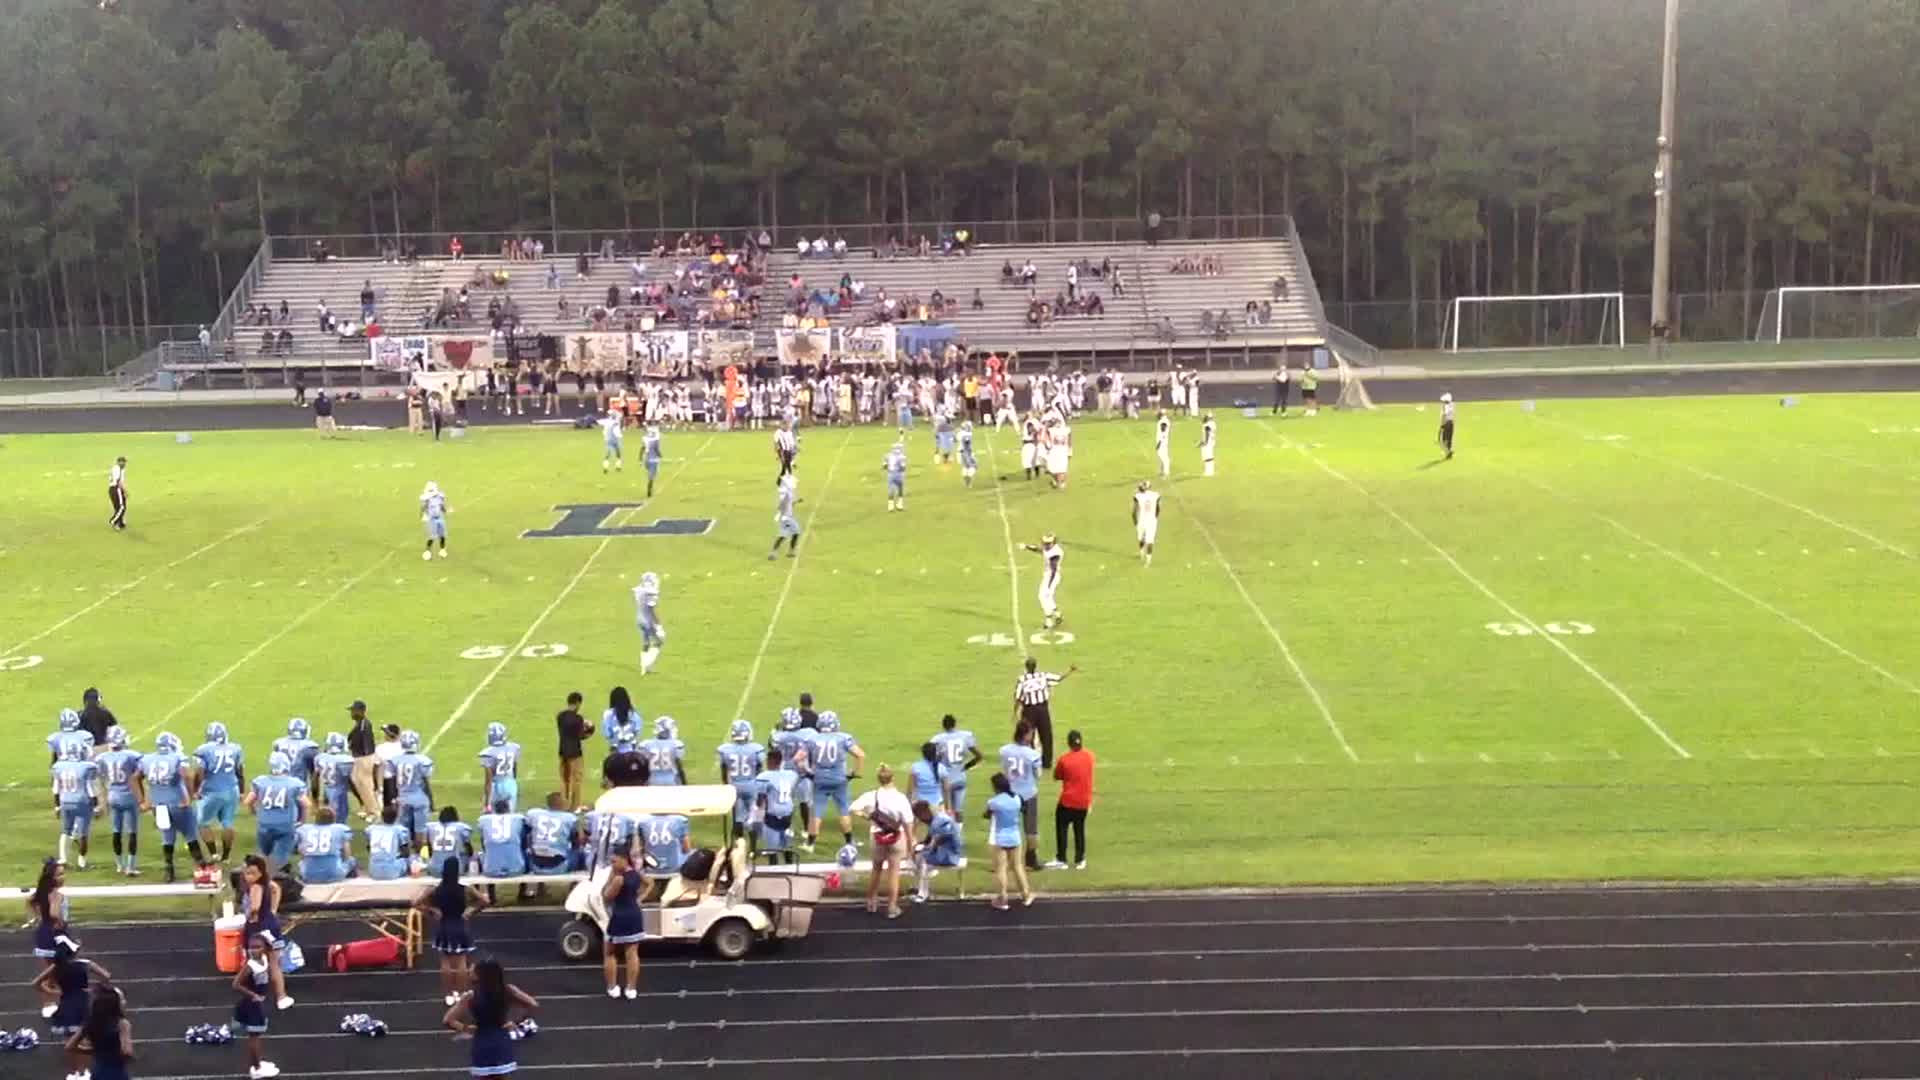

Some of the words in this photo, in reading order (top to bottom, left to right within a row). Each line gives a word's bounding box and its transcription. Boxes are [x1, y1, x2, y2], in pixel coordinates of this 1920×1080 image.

[518, 502, 717, 539] L
[966, 631, 1076, 646] 40
[213, 749, 236, 774] 75
[495, 751, 515, 776] 23
[816, 740, 838, 764] 70
[398, 763, 415, 785] 19
[728, 754, 752, 777] 36
[262, 785, 287, 810] 64
[305, 828, 332, 853] 58
[432, 826, 457, 852] 25
[536, 818, 561, 842] 52
[649, 818, 673, 846] 66
